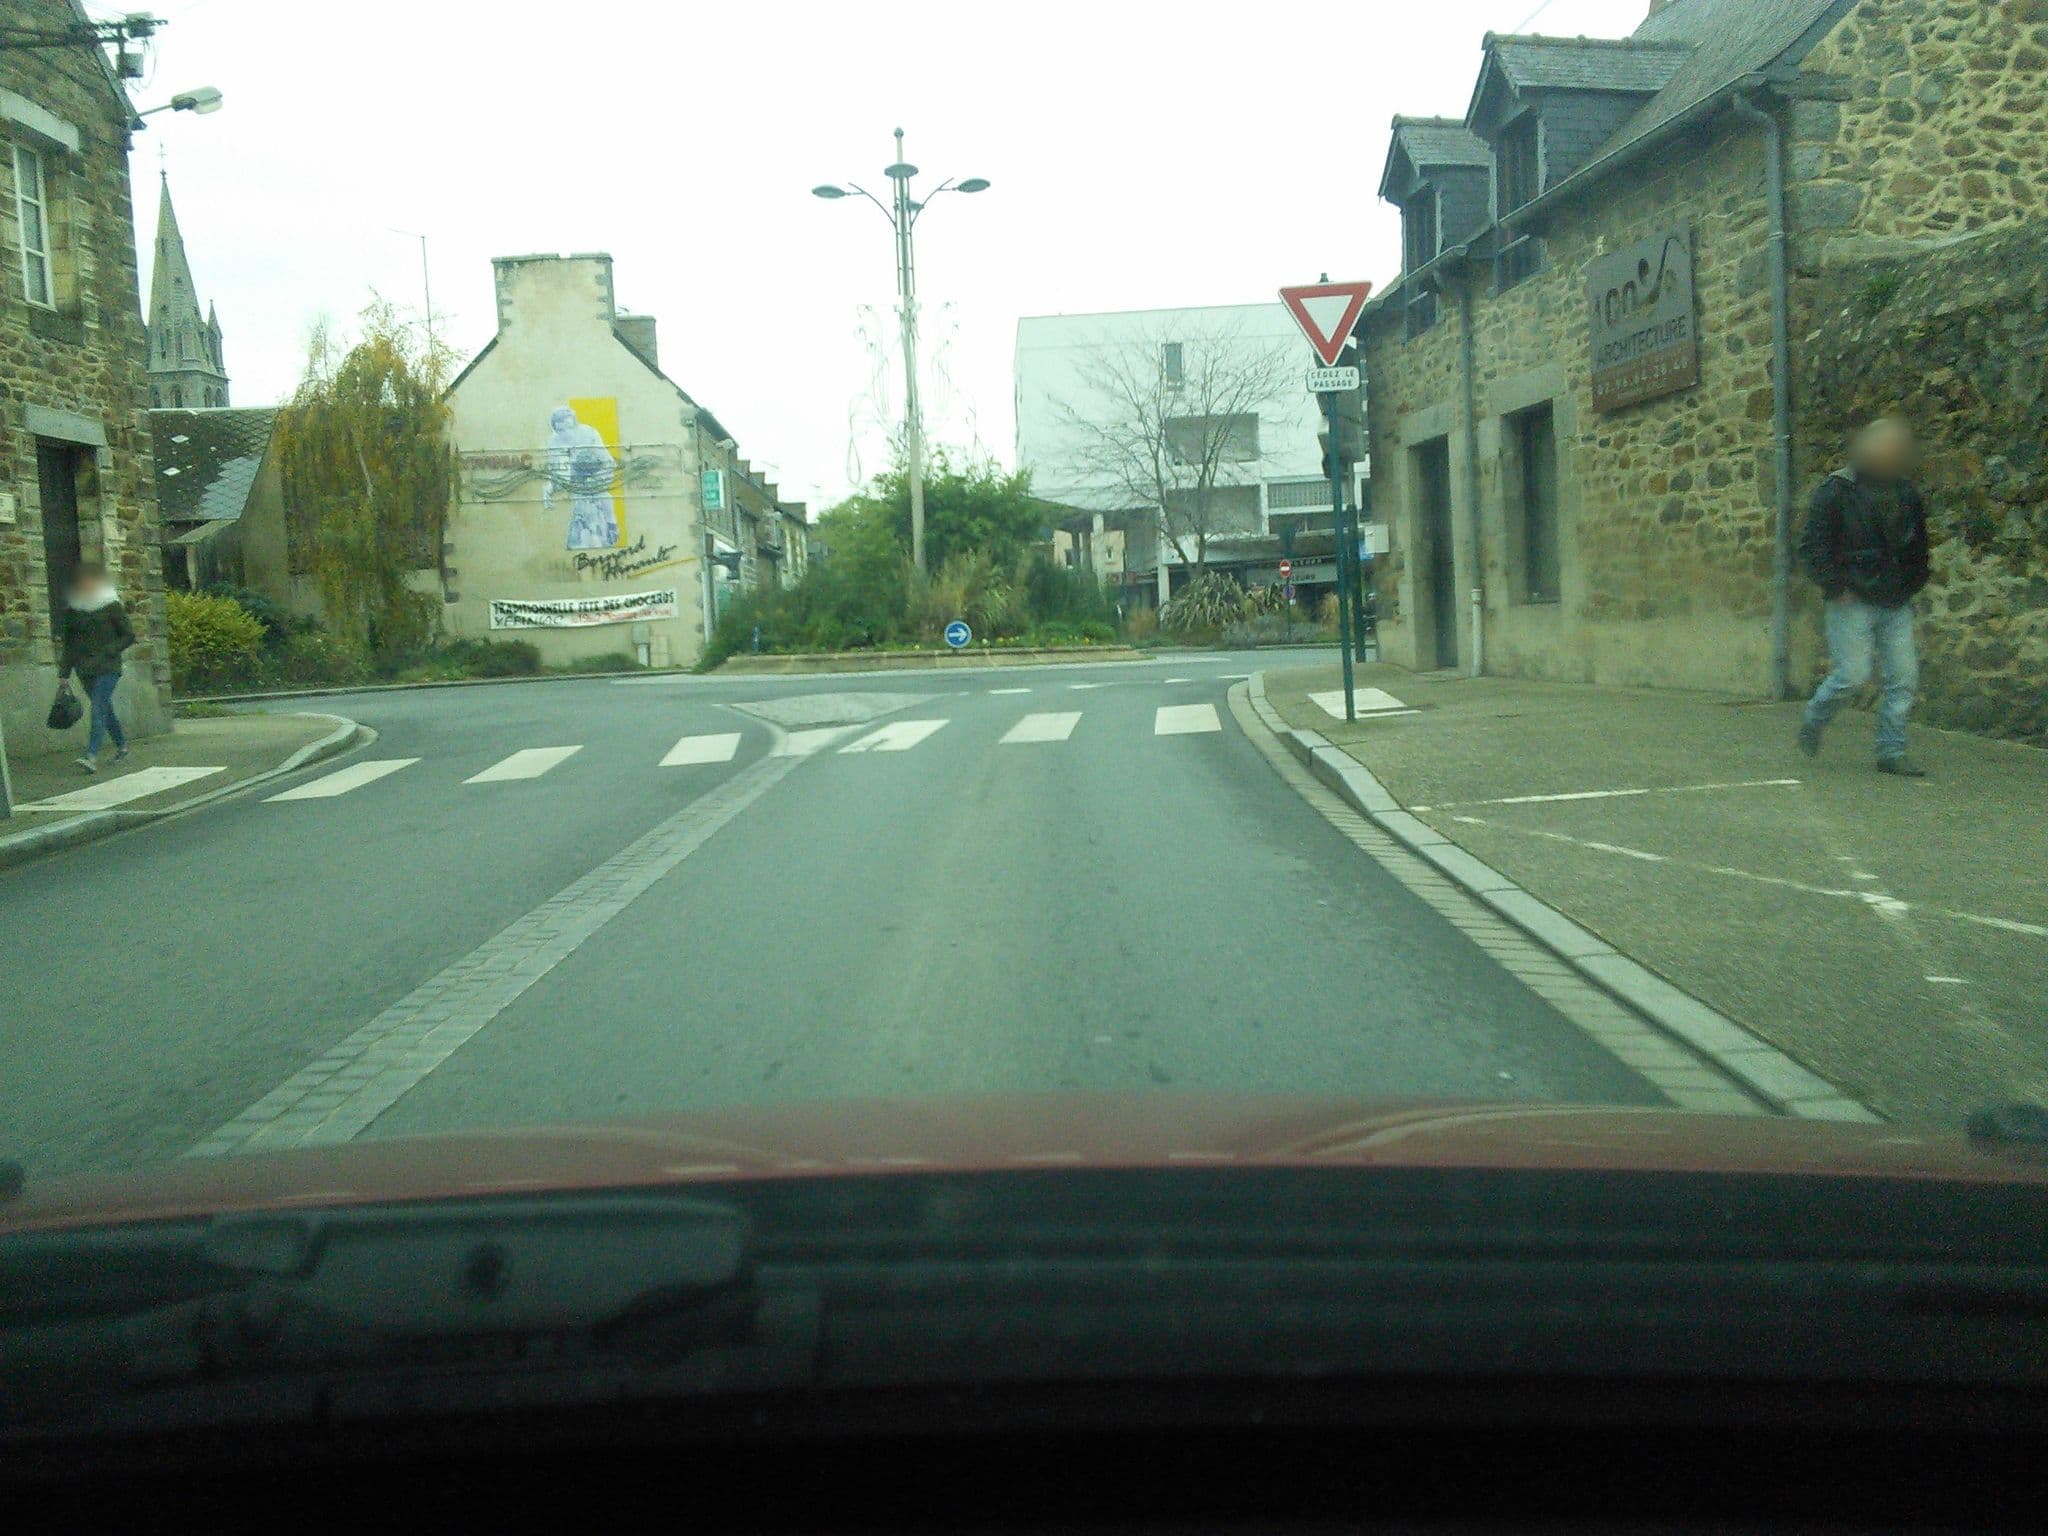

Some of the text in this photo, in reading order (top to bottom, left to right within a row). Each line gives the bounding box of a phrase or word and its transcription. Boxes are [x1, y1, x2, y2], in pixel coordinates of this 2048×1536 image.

[1597, 313, 1688, 367] ARCHITECTURE
[1345, 369, 1355, 378] LE
[1314, 379, 1352, 388] PASSAGE
[494, 600, 574, 616] TRADITIONNELLE
[603, 598, 621, 611] DES
